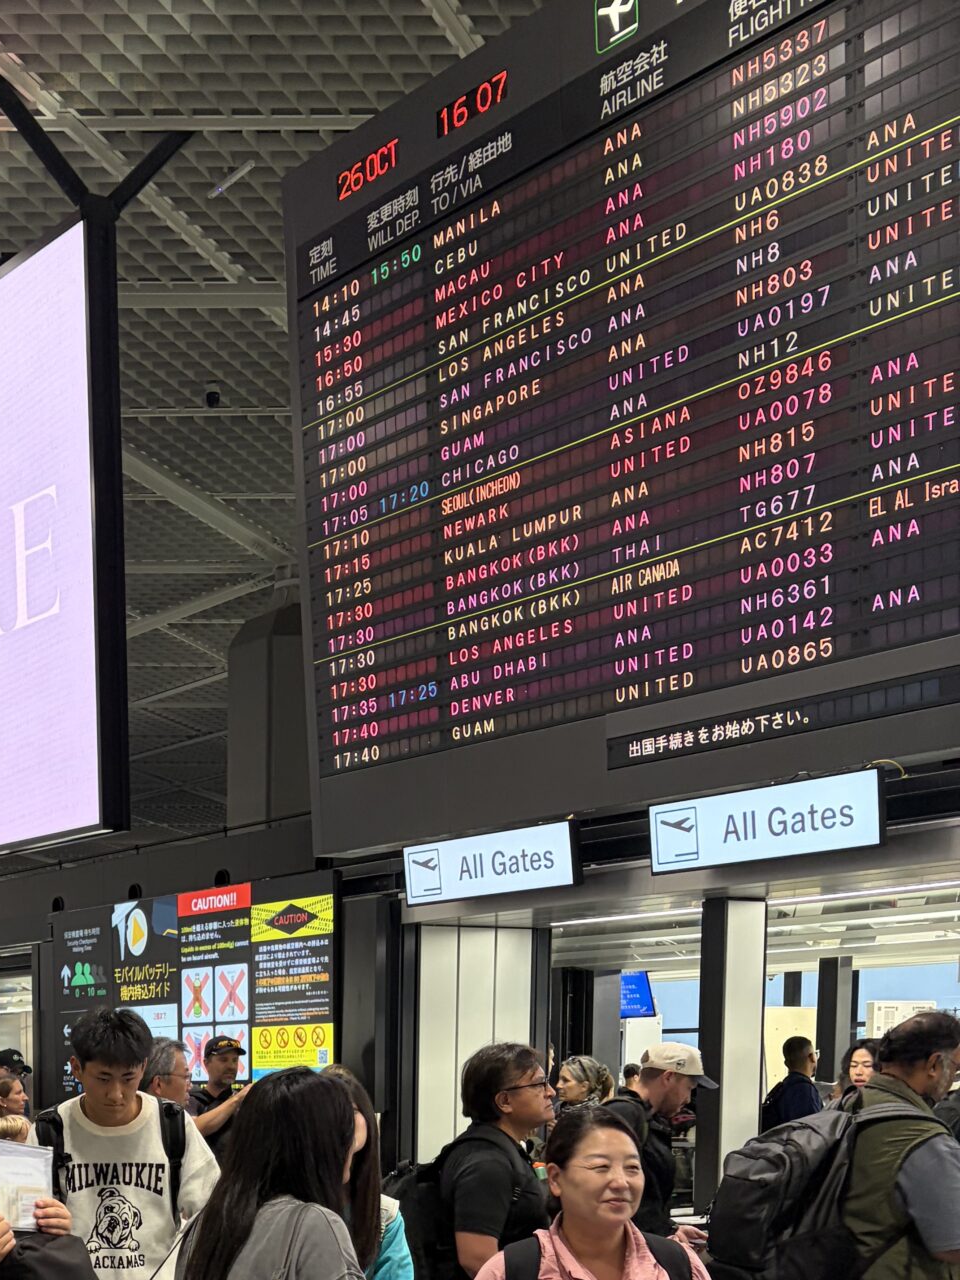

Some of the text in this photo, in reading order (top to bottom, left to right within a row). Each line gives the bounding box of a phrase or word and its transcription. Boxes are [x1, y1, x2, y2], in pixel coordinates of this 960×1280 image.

[600, 40, 668, 96] 航空会社
[729, 0, 792, 47] FLIGHT
[440, 71, 508, 136] 16 07
[601, 70, 664, 120] AIRLINE
[313, 19, 827, 318] 14:10 15:50 MANILA ANA NH5337
[314, 54, 827, 342] 14:45 CEBU ANA NH5323
[315, 87, 827, 367] 15:30 MACAU ANA NH5902
[367, 186, 419, 232] 変更時刻
[368, 210, 421, 252] WILL DEP.
[431, 193, 449, 214] TO
[460, 174, 483, 198] VIA
[309, 238, 332, 267] 定刻
[310, 261, 337, 284] TIME
[315, 129, 811, 392] 16:50 MEXICO CITY ANA NH180
[317, 113, 916, 416] 16:55 SAN FRANCISCO UNITED UA0838 ANA
[318, 129, 953, 441] 17:00 LOS ANGELES ANA NH6 UNITE
[319, 164, 953, 465] 17:00 SAN FRANCISCO ANA NH8 UNITE
[320, 199, 953, 489] 17:00 SINGAPORE ANA NH803 UNITE
[321, 250, 918, 512] 17:00 GUAM UNITED UA0197 ANA
[322, 269, 954, 536] 17:05 17:20 CHICAGO ANA NH12 UNITE
[323, 350, 832, 560] 17:10 SEOUL(INCHEON) ASIANA OZ9846
[324, 352, 919, 584] 17:15 NEWARK UNITED UA0078 ANA
[326, 372, 955, 607] 17:25 KUALA LUMPUR ANA NH815 UNITE
[327, 602, 373, 630] 17:30
[612, 510, 650, 537] ANA
[740, 453, 816, 494] NH807
[870, 406, 955, 449] UNITE
[328, 626, 374, 654] 17:30
[612, 534, 661, 564] THAI
[741, 484, 816, 523] TG677
[871, 452, 920, 482] ANA
[329, 650, 375, 677] 17:30
[611, 569, 633, 595] AIR
[638, 558, 680, 587] CANADA
[741, 511, 833, 554] AC7412
[869, 495, 887, 518] EL
[895, 487, 914, 511] AL
[925, 479, 960, 502] Isra
[331, 518, 920, 700] 17:30 LOS ANGELES UNITED UA0033 ANA
[331, 575, 830, 723] 17:35 17:25 ABU DHABI ANA NH6361
[332, 584, 920, 747] 17:40 DENVER UNITED UA0142 ANA
[334, 637, 833, 770] 17:40 GUAM UNITED UA0865
[628, 709, 810, 758] 出国手続きをお始め下さい。
[458, 846, 555, 880] All Gates
[722, 802, 855, 844] All Gates
[191, 892, 237, 911] CAUTION!!
[273, 912, 308, 926] CAUTION
[114, 962, 177, 983] モバイルバッテリー
[120, 981, 171, 1001] 機内持込ガイド
[65, 1162, 166, 1197] MILWAUKIE
[93, 1254, 146, 1270] ACKAMAS
